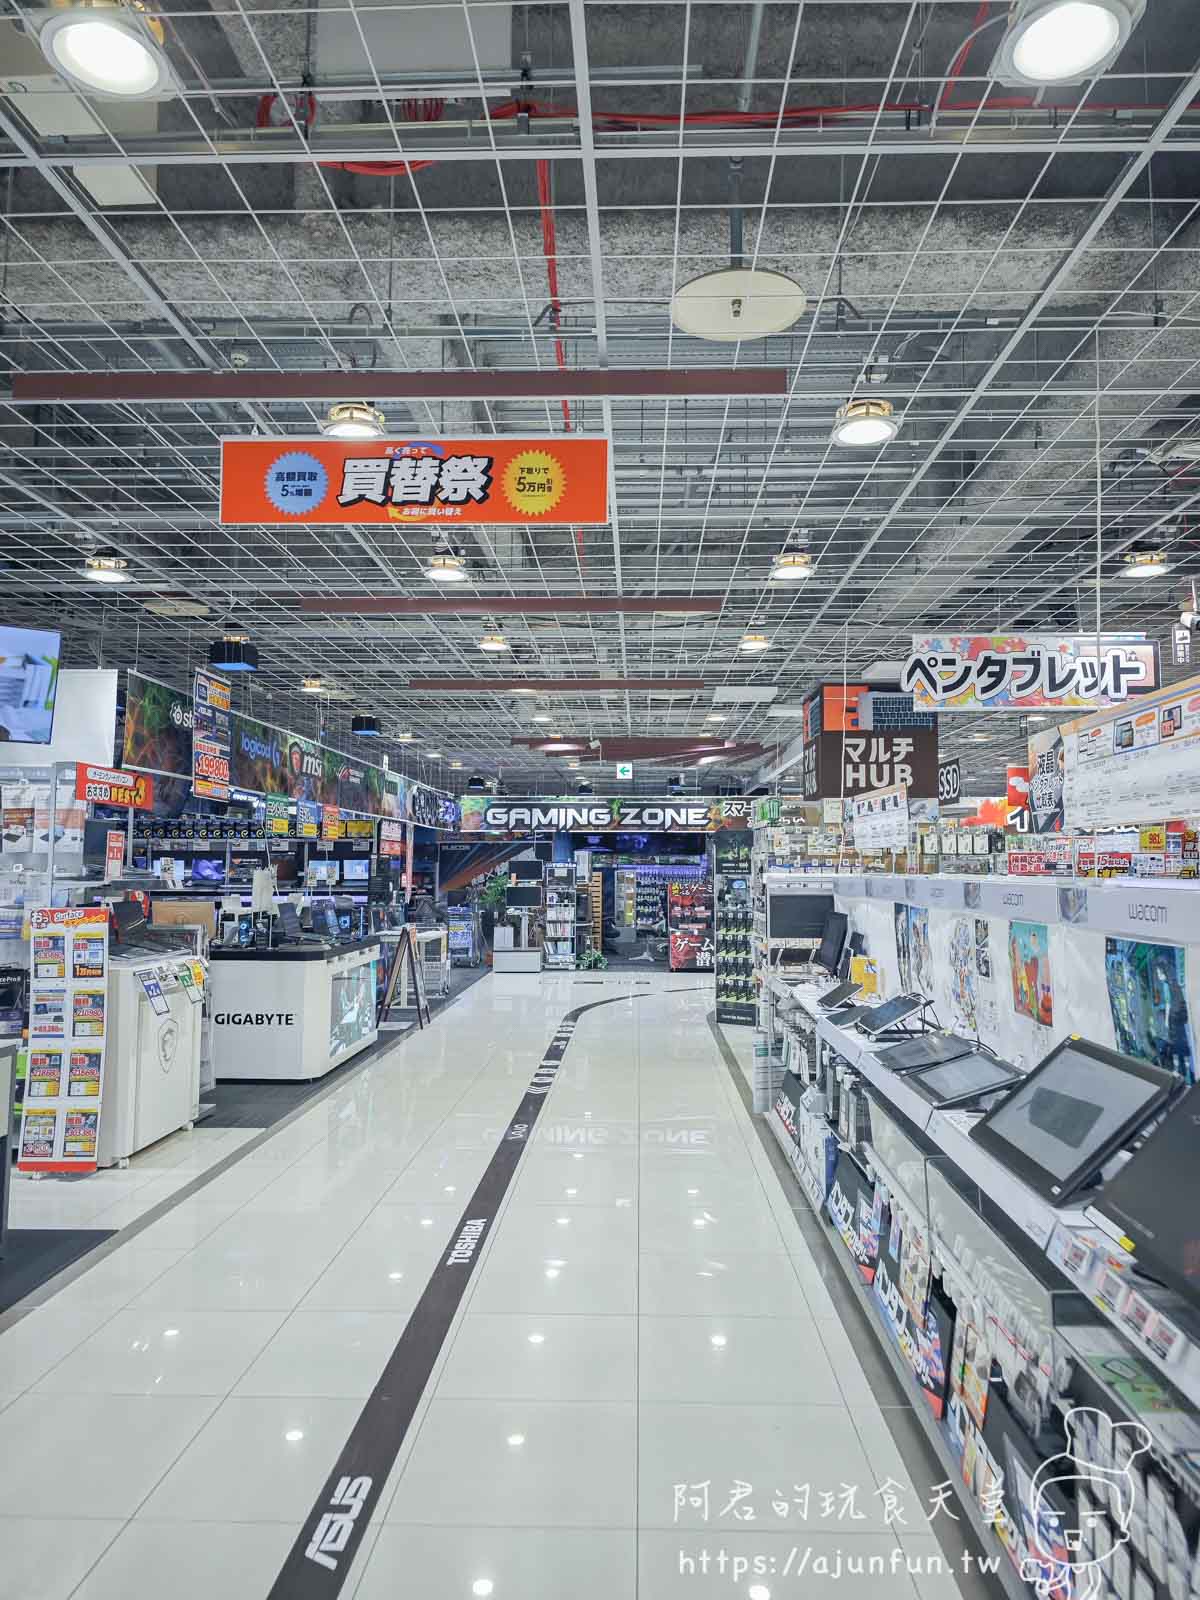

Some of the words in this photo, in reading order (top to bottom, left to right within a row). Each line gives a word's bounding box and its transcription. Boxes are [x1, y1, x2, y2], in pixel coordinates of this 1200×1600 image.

[338, 455, 491, 507] 買替祭
[903, 646, 1146, 697] ペンタブレット
[843, 737, 914, 762] マルチ
[303, 755, 322, 776] msi
[845, 764, 914, 788] HUB
[938, 765, 960, 801] SSD
[485, 808, 611, 831] GAMING
[619, 808, 711, 831] ZONE
[1128, 903, 1168, 925] wacom
[214, 1013, 294, 1026] GIGABYTE
[446, 1218, 488, 1266] TOSHIBA
[304, 1475, 373, 1571] ASUS
